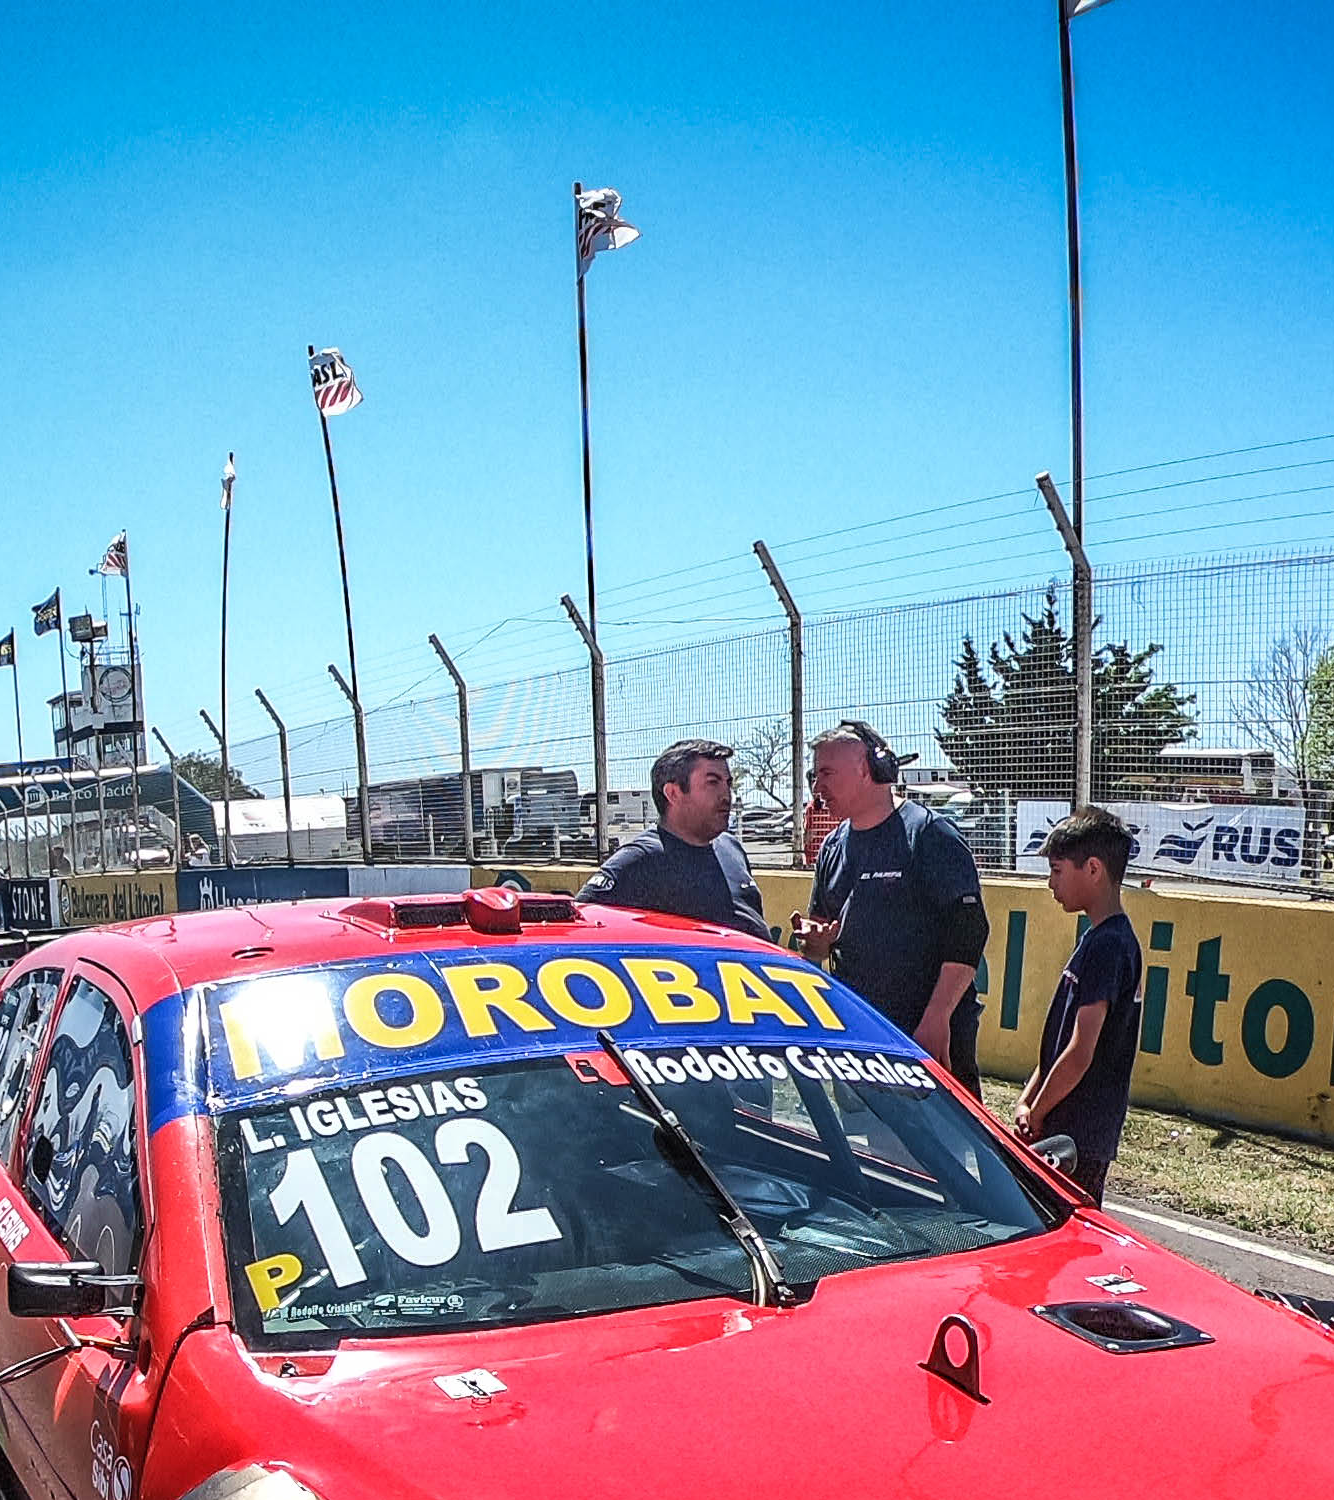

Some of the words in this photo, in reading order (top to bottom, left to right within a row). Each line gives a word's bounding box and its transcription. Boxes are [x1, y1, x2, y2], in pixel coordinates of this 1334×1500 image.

[1212, 826, 1302, 869] RUS
[219, 956, 846, 1081] MOROBAT
[625, 1048, 787, 1088] Rodolfo
[794, 1046, 936, 1090] Cristales
[239, 1117, 286, 1156] L.
[291, 1075, 490, 1143] IGLESIAS
[269, 1116, 564, 1289] 102
[243, 1251, 304, 1313] P
[90, 1419, 114, 1473] Casa
